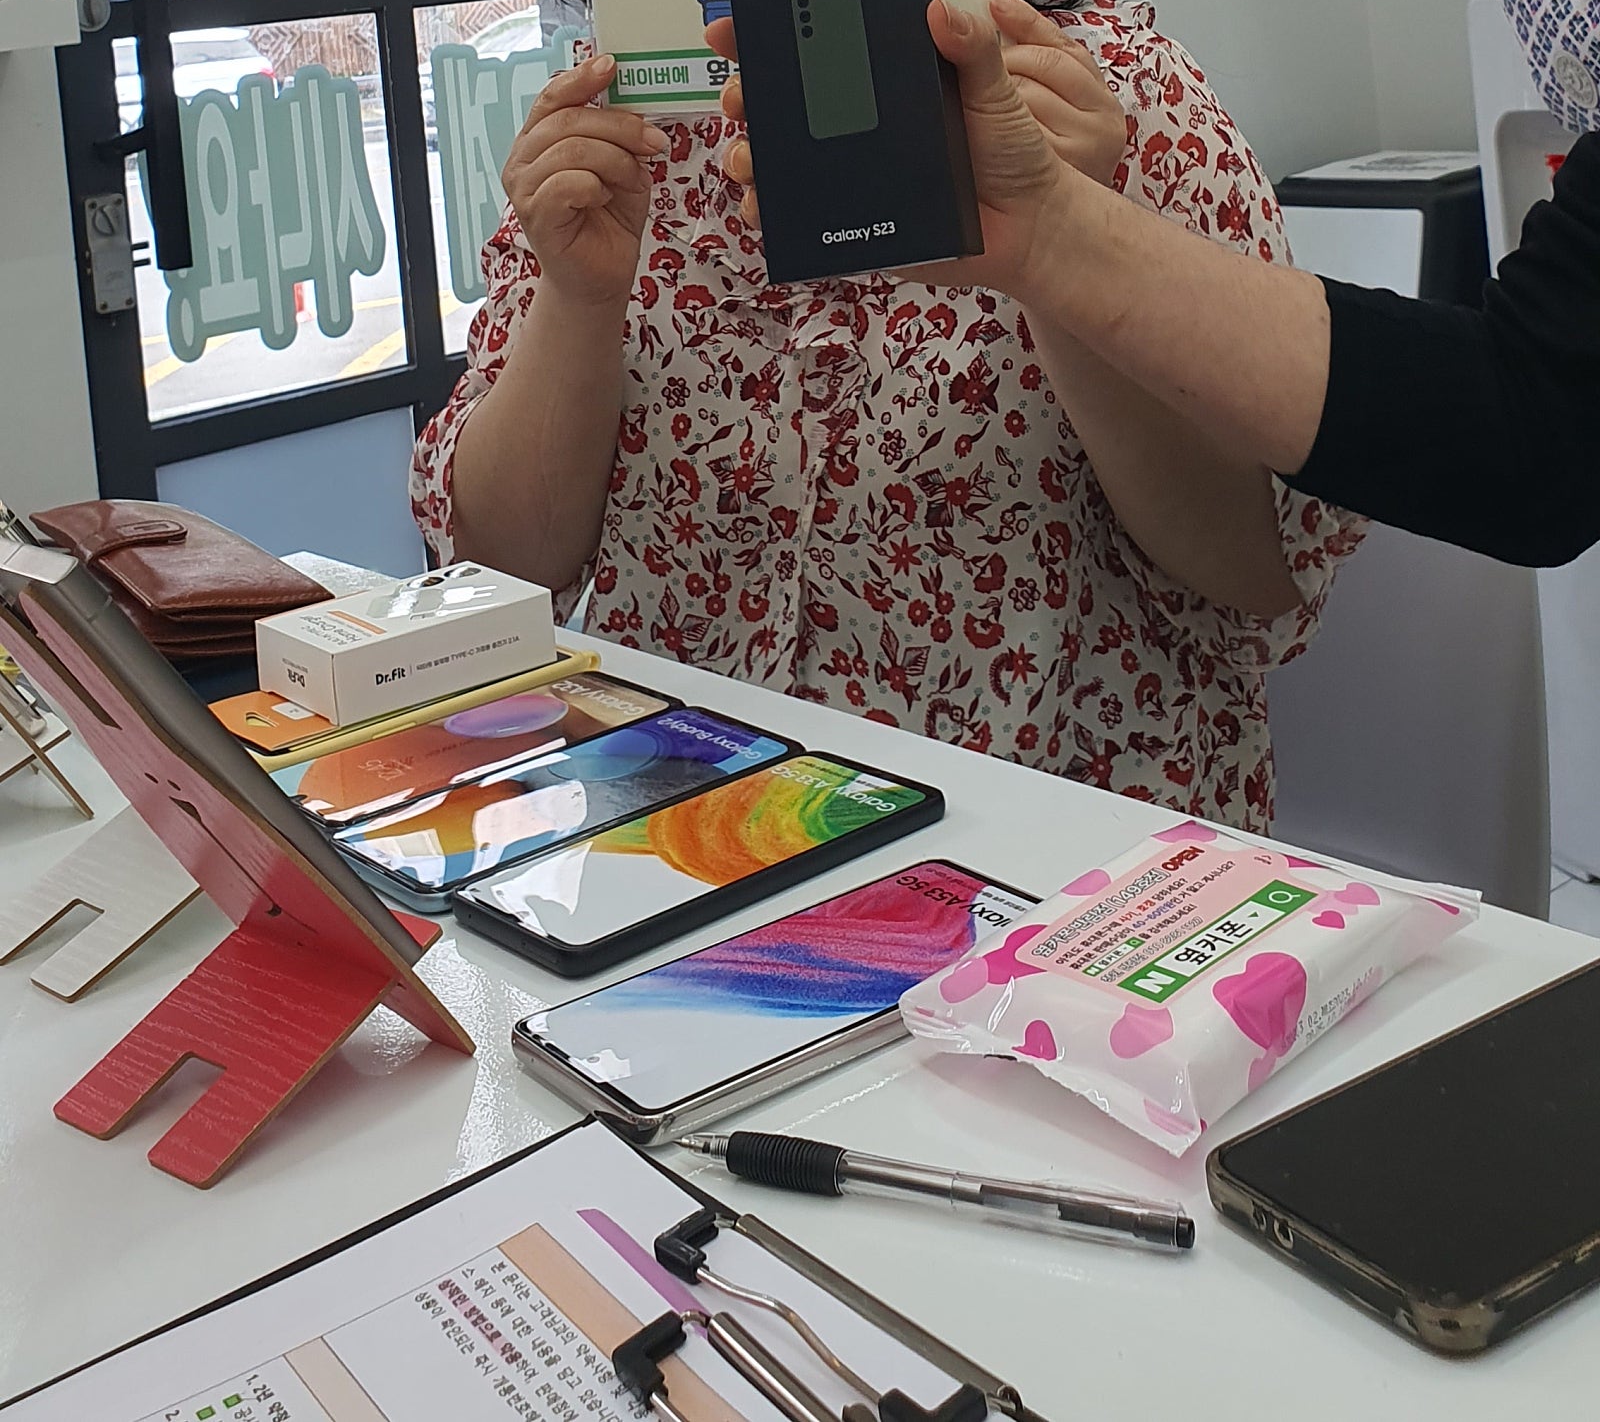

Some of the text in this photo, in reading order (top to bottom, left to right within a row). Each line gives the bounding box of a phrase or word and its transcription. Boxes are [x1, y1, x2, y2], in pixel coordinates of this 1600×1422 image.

[618, 59, 740, 86] 네이버에 옆
[822, 221, 896, 244] Galaxy S23
[375, 666, 406, 686] Dr.Fit
[552, 679, 646, 715] Galaxy A32
[656, 718, 714, 740] Buddy2
[707, 735, 762, 759] Galaxy
[771, 765, 800, 779] 5G
[794, 774, 834, 789] A33
[829, 786, 897, 812] Galaxy
[1162, 846, 1204, 871] OPEN
[896, 875, 930, 892] 5G
[923, 887, 968, 906] A53
[1055, 946, 1084, 964] 아직도
[1133, 970, 1177, 994] N
[1174, 920, 1254, 966] 옆커폰
[490, 1261, 508, 1274] 본
[502, 1273, 530, 1300] 문서는
[530, 1301, 577, 1344] 고객님과의
[441, 1318, 475, 1354] 확인되는
[475, 1354, 498, 1376] 즉시
[512, 1316, 534, 1338] 대한
[532, 1337, 561, 1367] 내용을
[557, 1366, 582, 1389] 담고
